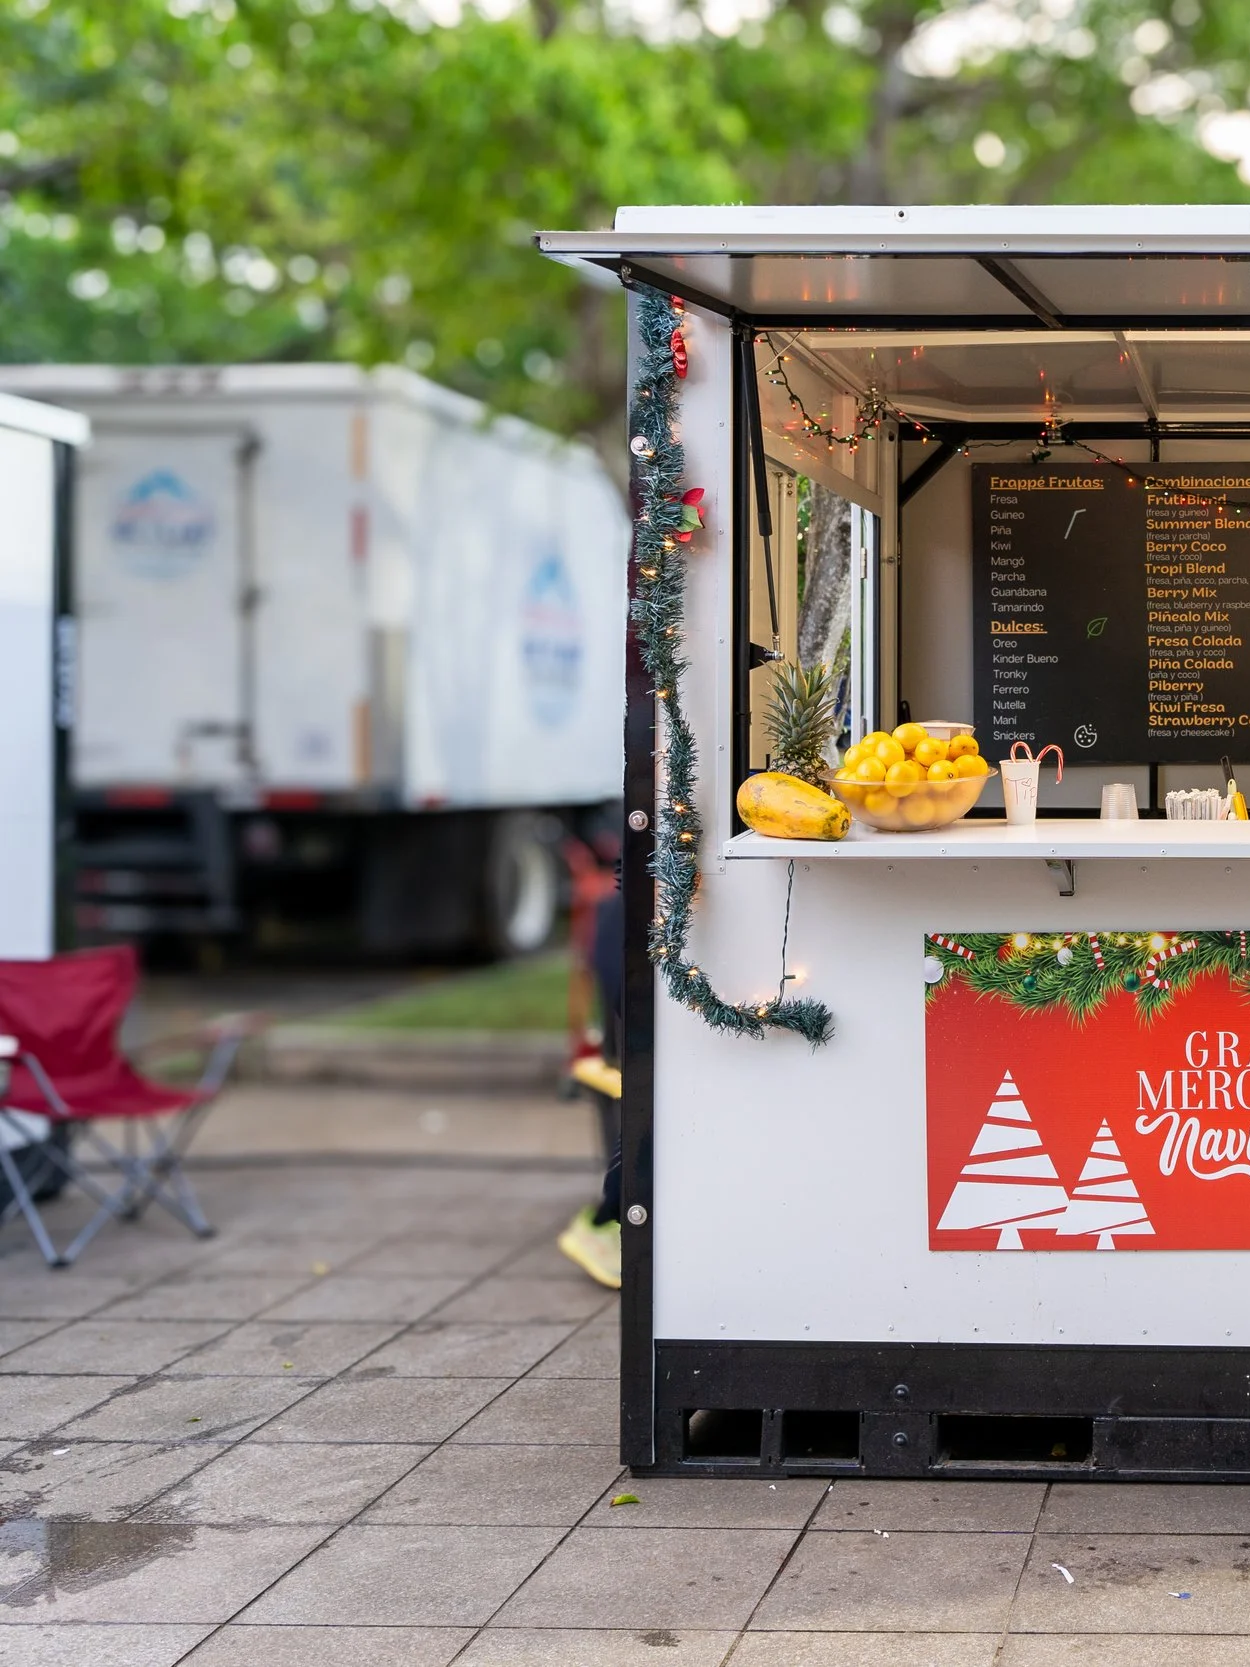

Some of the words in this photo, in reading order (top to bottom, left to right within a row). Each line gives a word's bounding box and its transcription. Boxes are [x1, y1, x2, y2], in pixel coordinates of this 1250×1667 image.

[990, 476, 1045, 489] Frappé
[1049, 476, 1104, 488] Frutas:
[990, 495, 1018, 503] Fresa
[990, 510, 1025, 519] Guineo
[1146, 508, 1169, 518] (fresa
[1179, 508, 1209, 518] guineo)
[1145, 518, 1211, 529] Summer
[990, 525, 1012, 534] Piña
[1146, 531, 1169, 541] (fresa
[1179, 531, 1211, 541] parcha)
[990, 541, 1011, 549] Kiwi
[1145, 541, 1187, 554] Berry
[1191, 541, 1227, 553] Coco
[990, 556, 1025, 567] Mangó
[1146, 553, 1170, 562] (fresa
[1179, 553, 1202, 562] coco)
[1144, 562, 1182, 575] Tropi
[1186, 562, 1226, 575] Blend
[990, 571, 1026, 580] Parcha
[1146, 575, 1173, 586] (fresa,
[1174, 575, 1192, 586] piña,
[1195, 575, 1216, 586] coco,
[1218, 575, 1249, 586] parcha,
[990, 587, 1047, 596] Guanábana
[1146, 587, 1188, 600] Berry
[1193, 587, 1217, 599] Mix
[991, 602, 1044, 611] Tamarindo
[1147, 600, 1171, 611] (fresa,
[1174, 600, 1213, 611] blueberry
[1148, 610, 1200, 623] Piñealo
[1205, 610, 1229, 622] Mix
[990, 620, 1048, 633] Dulces:
[1148, 623, 1172, 634] (fresa,
[1174, 623, 1191, 634] piña
[1201, 623, 1231, 634] guineo)
[992, 639, 1018, 647] Oreo
[1147, 635, 1188, 646] Fresa
[1192, 635, 1242, 646] Colada
[1149, 648, 1174, 657] (fresa,
[1176, 648, 1194, 657] piña
[1203, 648, 1226, 657] coco)
[992, 654, 1024, 663] Kinder
[1027, 654, 1058, 663] Bueno
[1148, 658, 1180, 669] Piña
[1184, 658, 1234, 669] Colada
[992, 670, 1028, 680] Tronky
[1148, 670, 1168, 680] (piña
[1177, 670, 1200, 680] coco)
[992, 685, 1029, 694] Ferrero
[1148, 680, 1203, 692] Piberry
[1148, 692, 1171, 702] (fresa
[992, 700, 1026, 709] Nutella
[1149, 701, 1180, 712] Kiwi
[1185, 701, 1225, 712] Fresa
[992, 715, 1017, 724] Maní
[1148, 714, 1235, 726] Strawberry
[992, 731, 1035, 740] Snickers
[1148, 728, 1171, 738] (fresa
